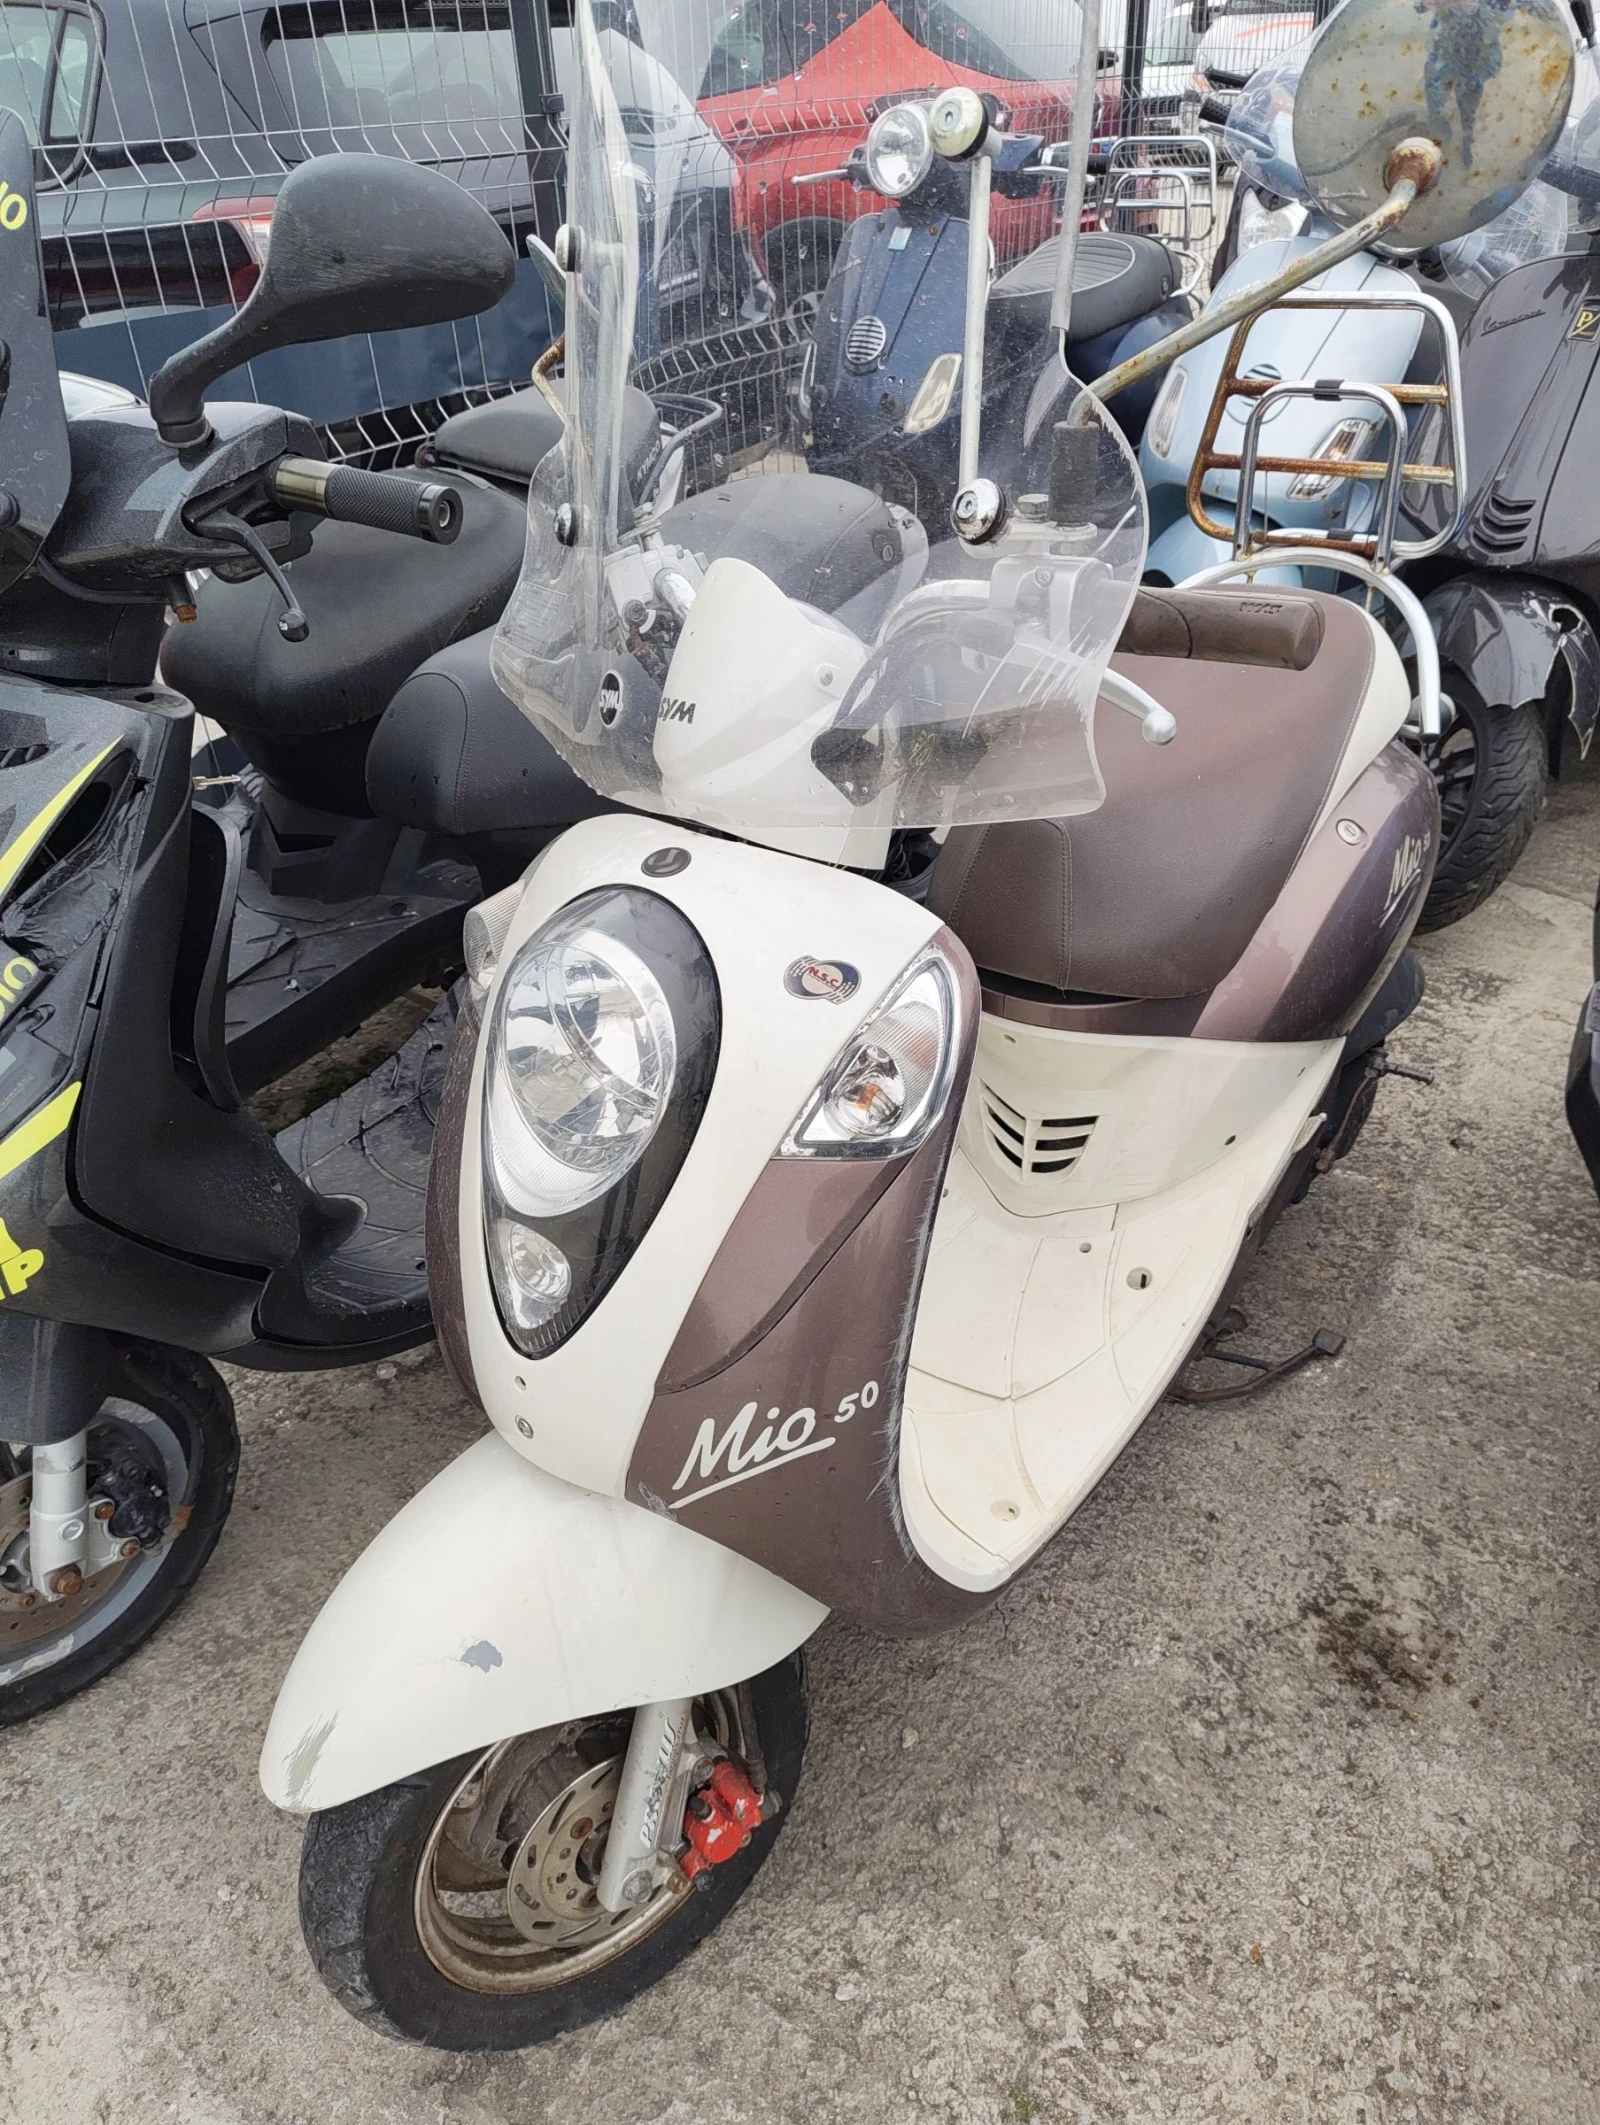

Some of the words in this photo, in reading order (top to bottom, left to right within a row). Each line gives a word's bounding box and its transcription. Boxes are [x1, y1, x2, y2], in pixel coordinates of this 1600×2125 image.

[600, 689, 619, 713] SYM
[659, 697, 696, 724] SYM
[1382, 834, 1422, 911] Mio
[671, 1401, 817, 1492] Mio
[834, 1380, 879, 1423] 50
